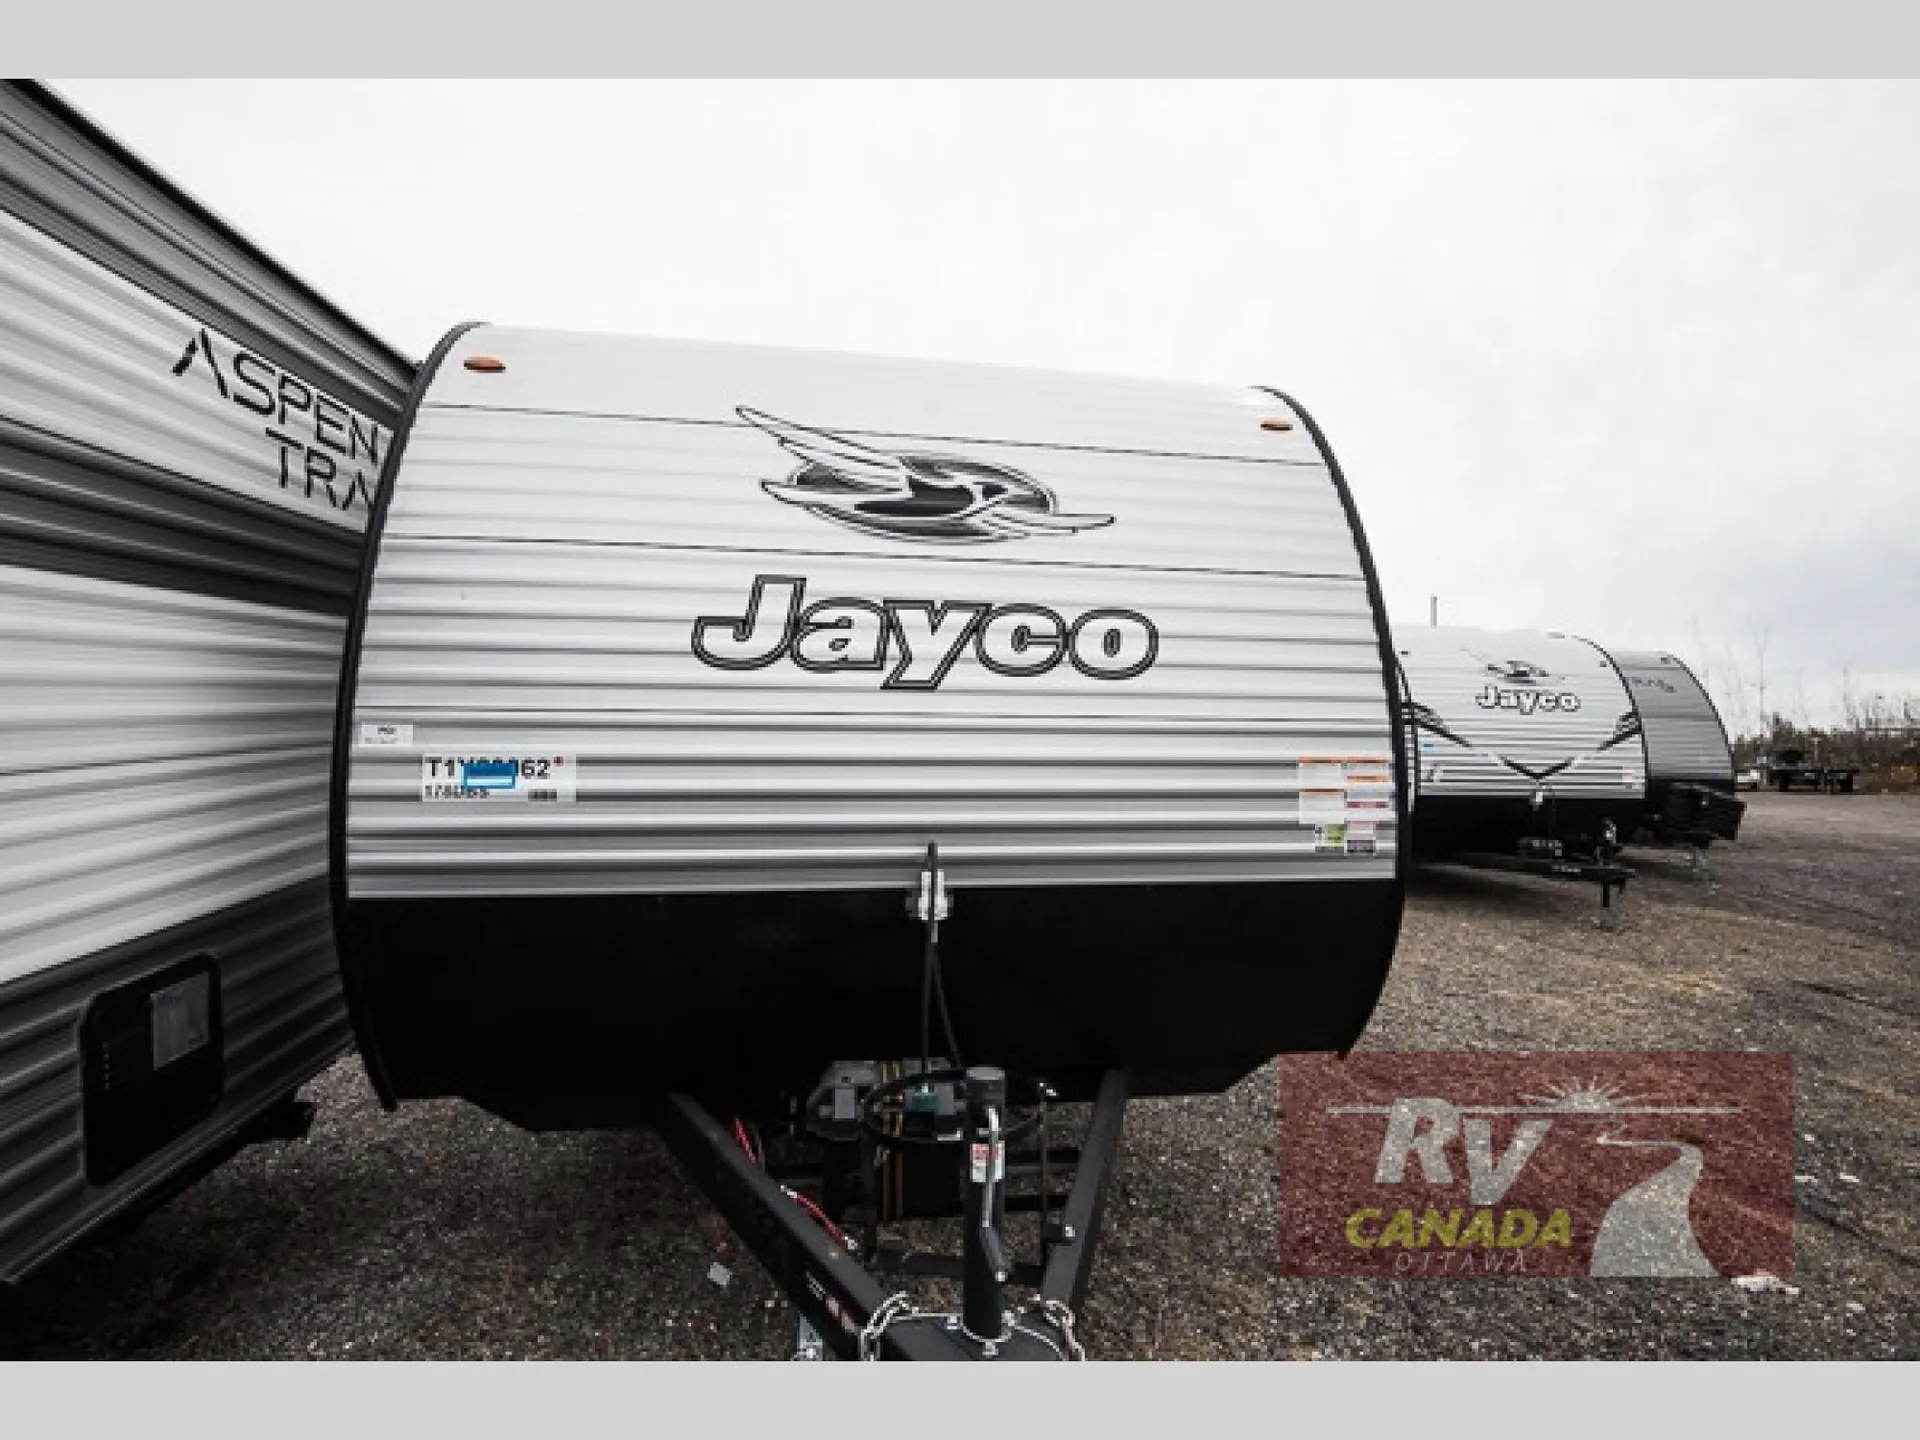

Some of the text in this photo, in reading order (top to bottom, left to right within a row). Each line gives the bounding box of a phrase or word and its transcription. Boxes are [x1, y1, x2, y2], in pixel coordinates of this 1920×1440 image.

[172, 328, 379, 466] ASPEN
[692, 574, 1159, 690] Jayco
[1475, 684, 1581, 715] Jayco
